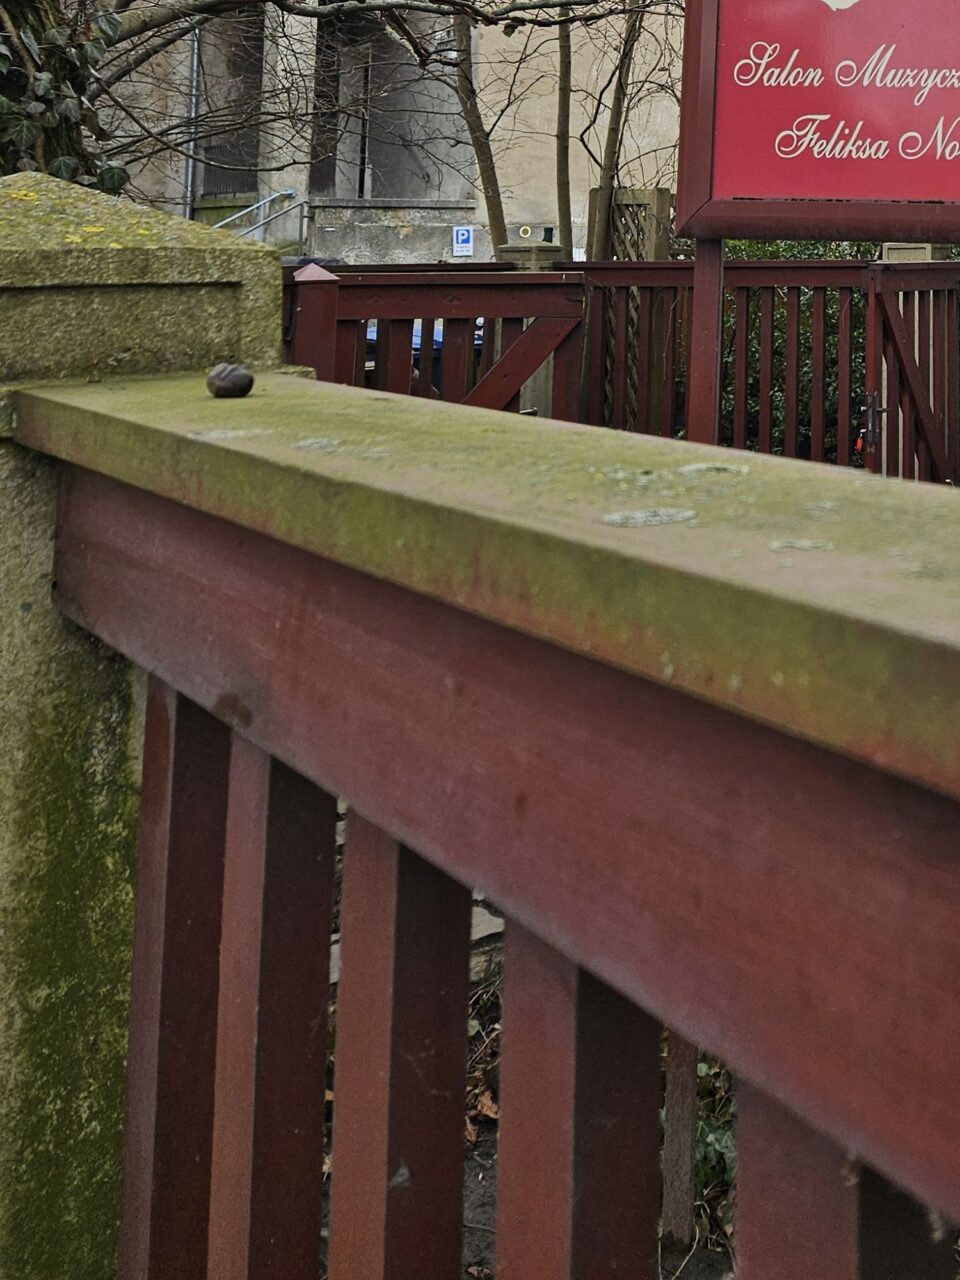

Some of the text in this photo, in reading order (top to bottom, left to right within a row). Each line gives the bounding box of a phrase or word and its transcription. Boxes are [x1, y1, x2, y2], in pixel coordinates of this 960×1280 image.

[733, 41, 824, 87] Salon
[774, 114, 889, 159] Feliksa
[457, 230, 469, 244] P
